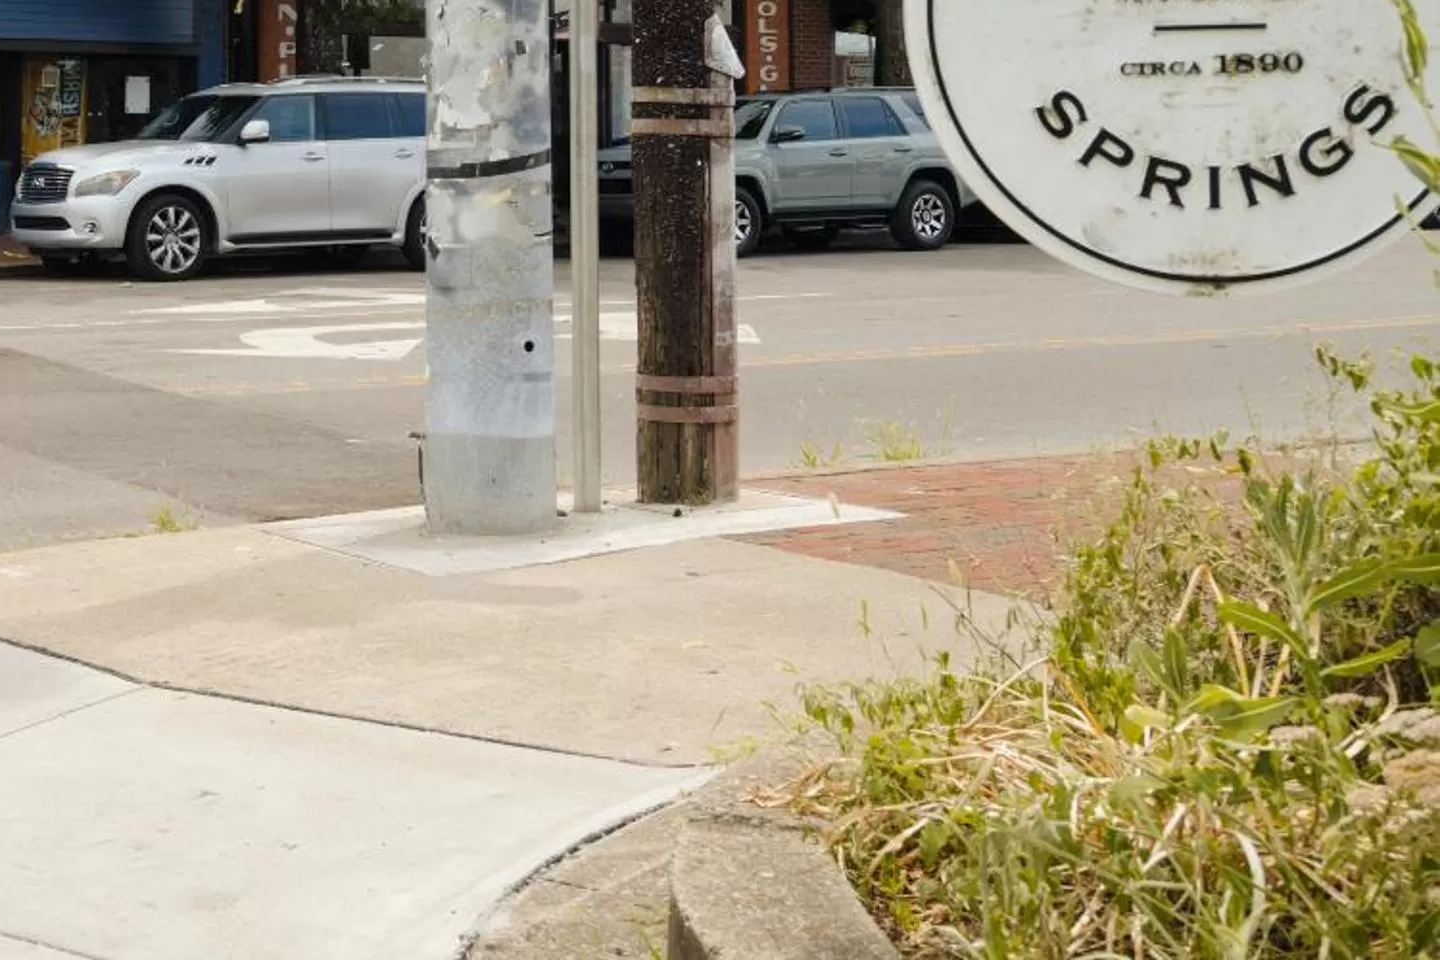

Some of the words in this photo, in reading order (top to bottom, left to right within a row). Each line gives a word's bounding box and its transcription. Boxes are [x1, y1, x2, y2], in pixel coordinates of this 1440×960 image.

[1119, 60, 1203, 77] CIRCA
[1214, 51, 1304, 75] 1890
[1033, 84, 1395, 211] SPRINGS
